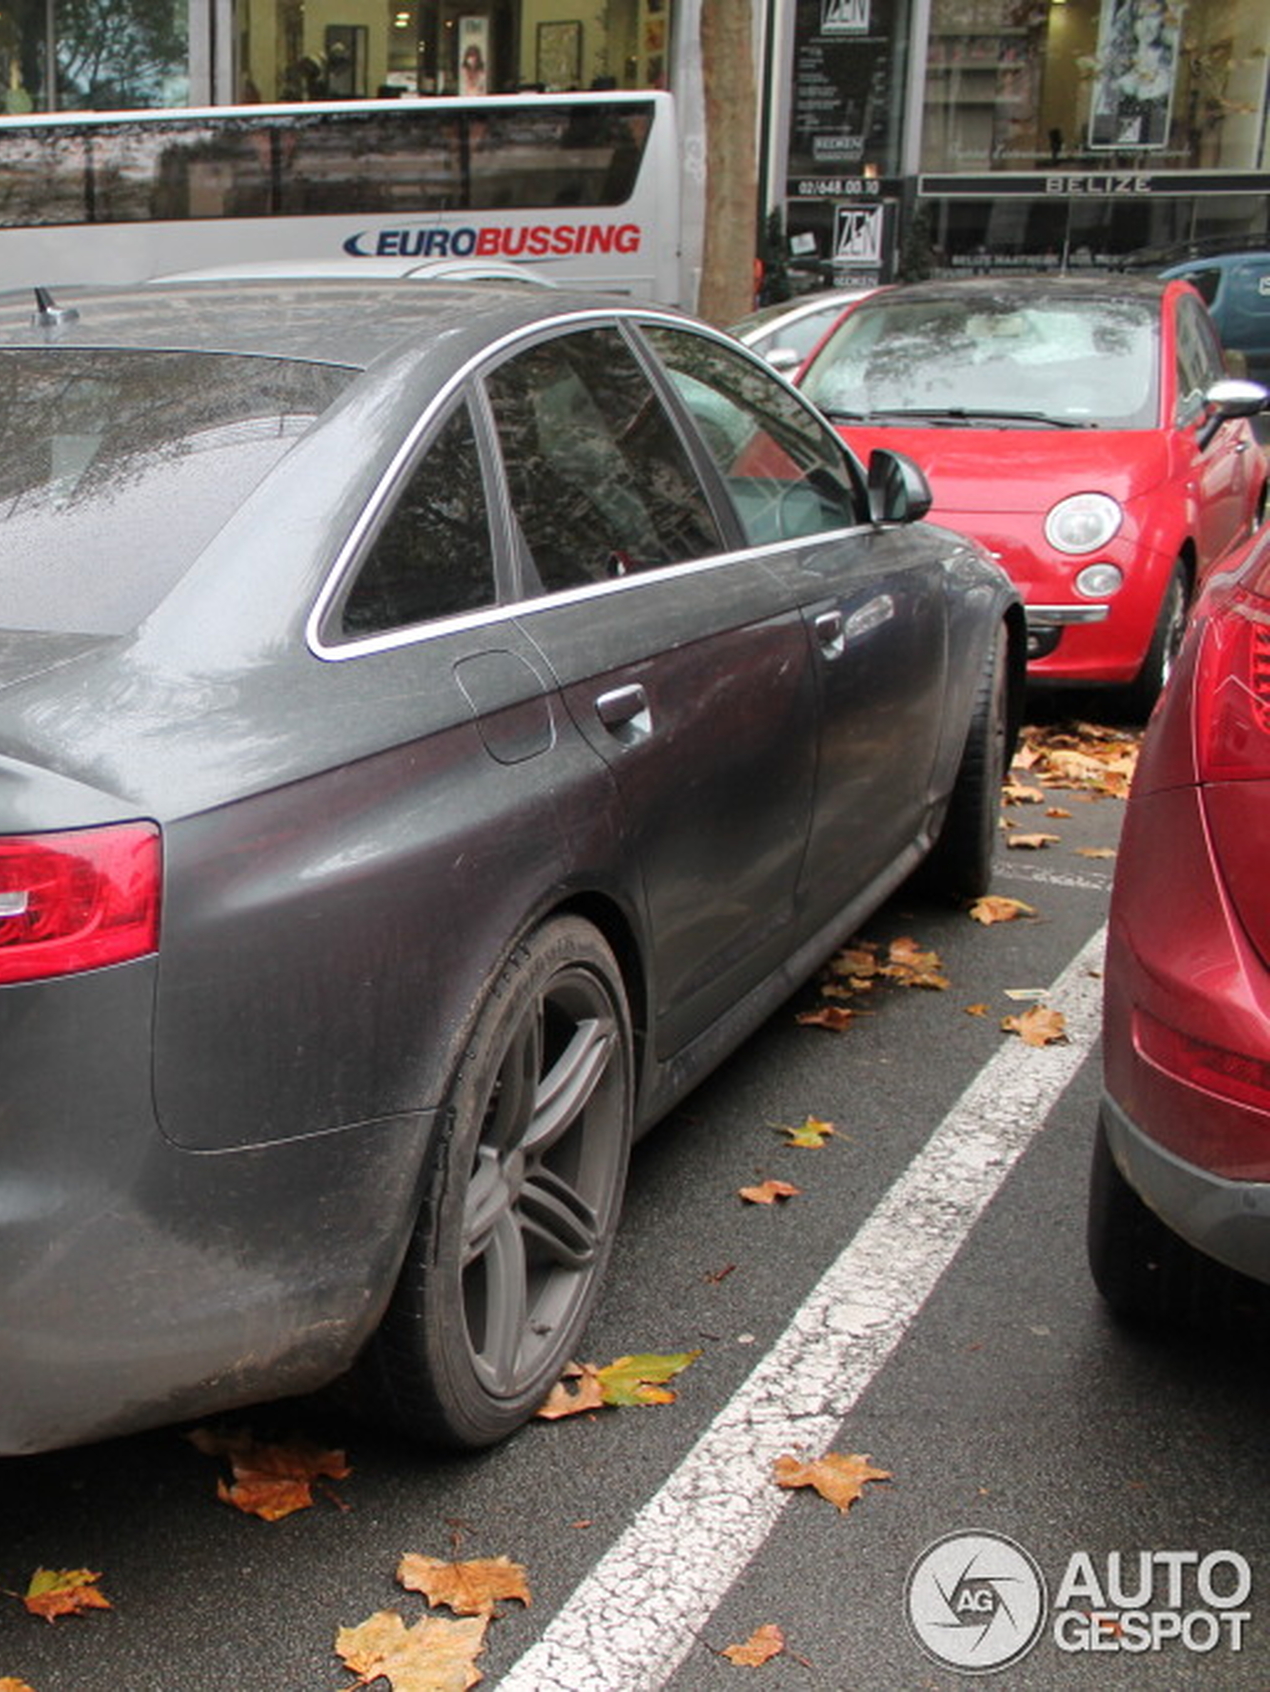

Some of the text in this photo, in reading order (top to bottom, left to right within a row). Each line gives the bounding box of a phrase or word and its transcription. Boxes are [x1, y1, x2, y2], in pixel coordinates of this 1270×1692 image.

[799, 180, 879, 195] 02/648.00.10
[1046, 177, 1151, 193] BELIZE
[376, 224, 640, 257] EUROBUSSING
[837, 211, 881, 257] ZEN
